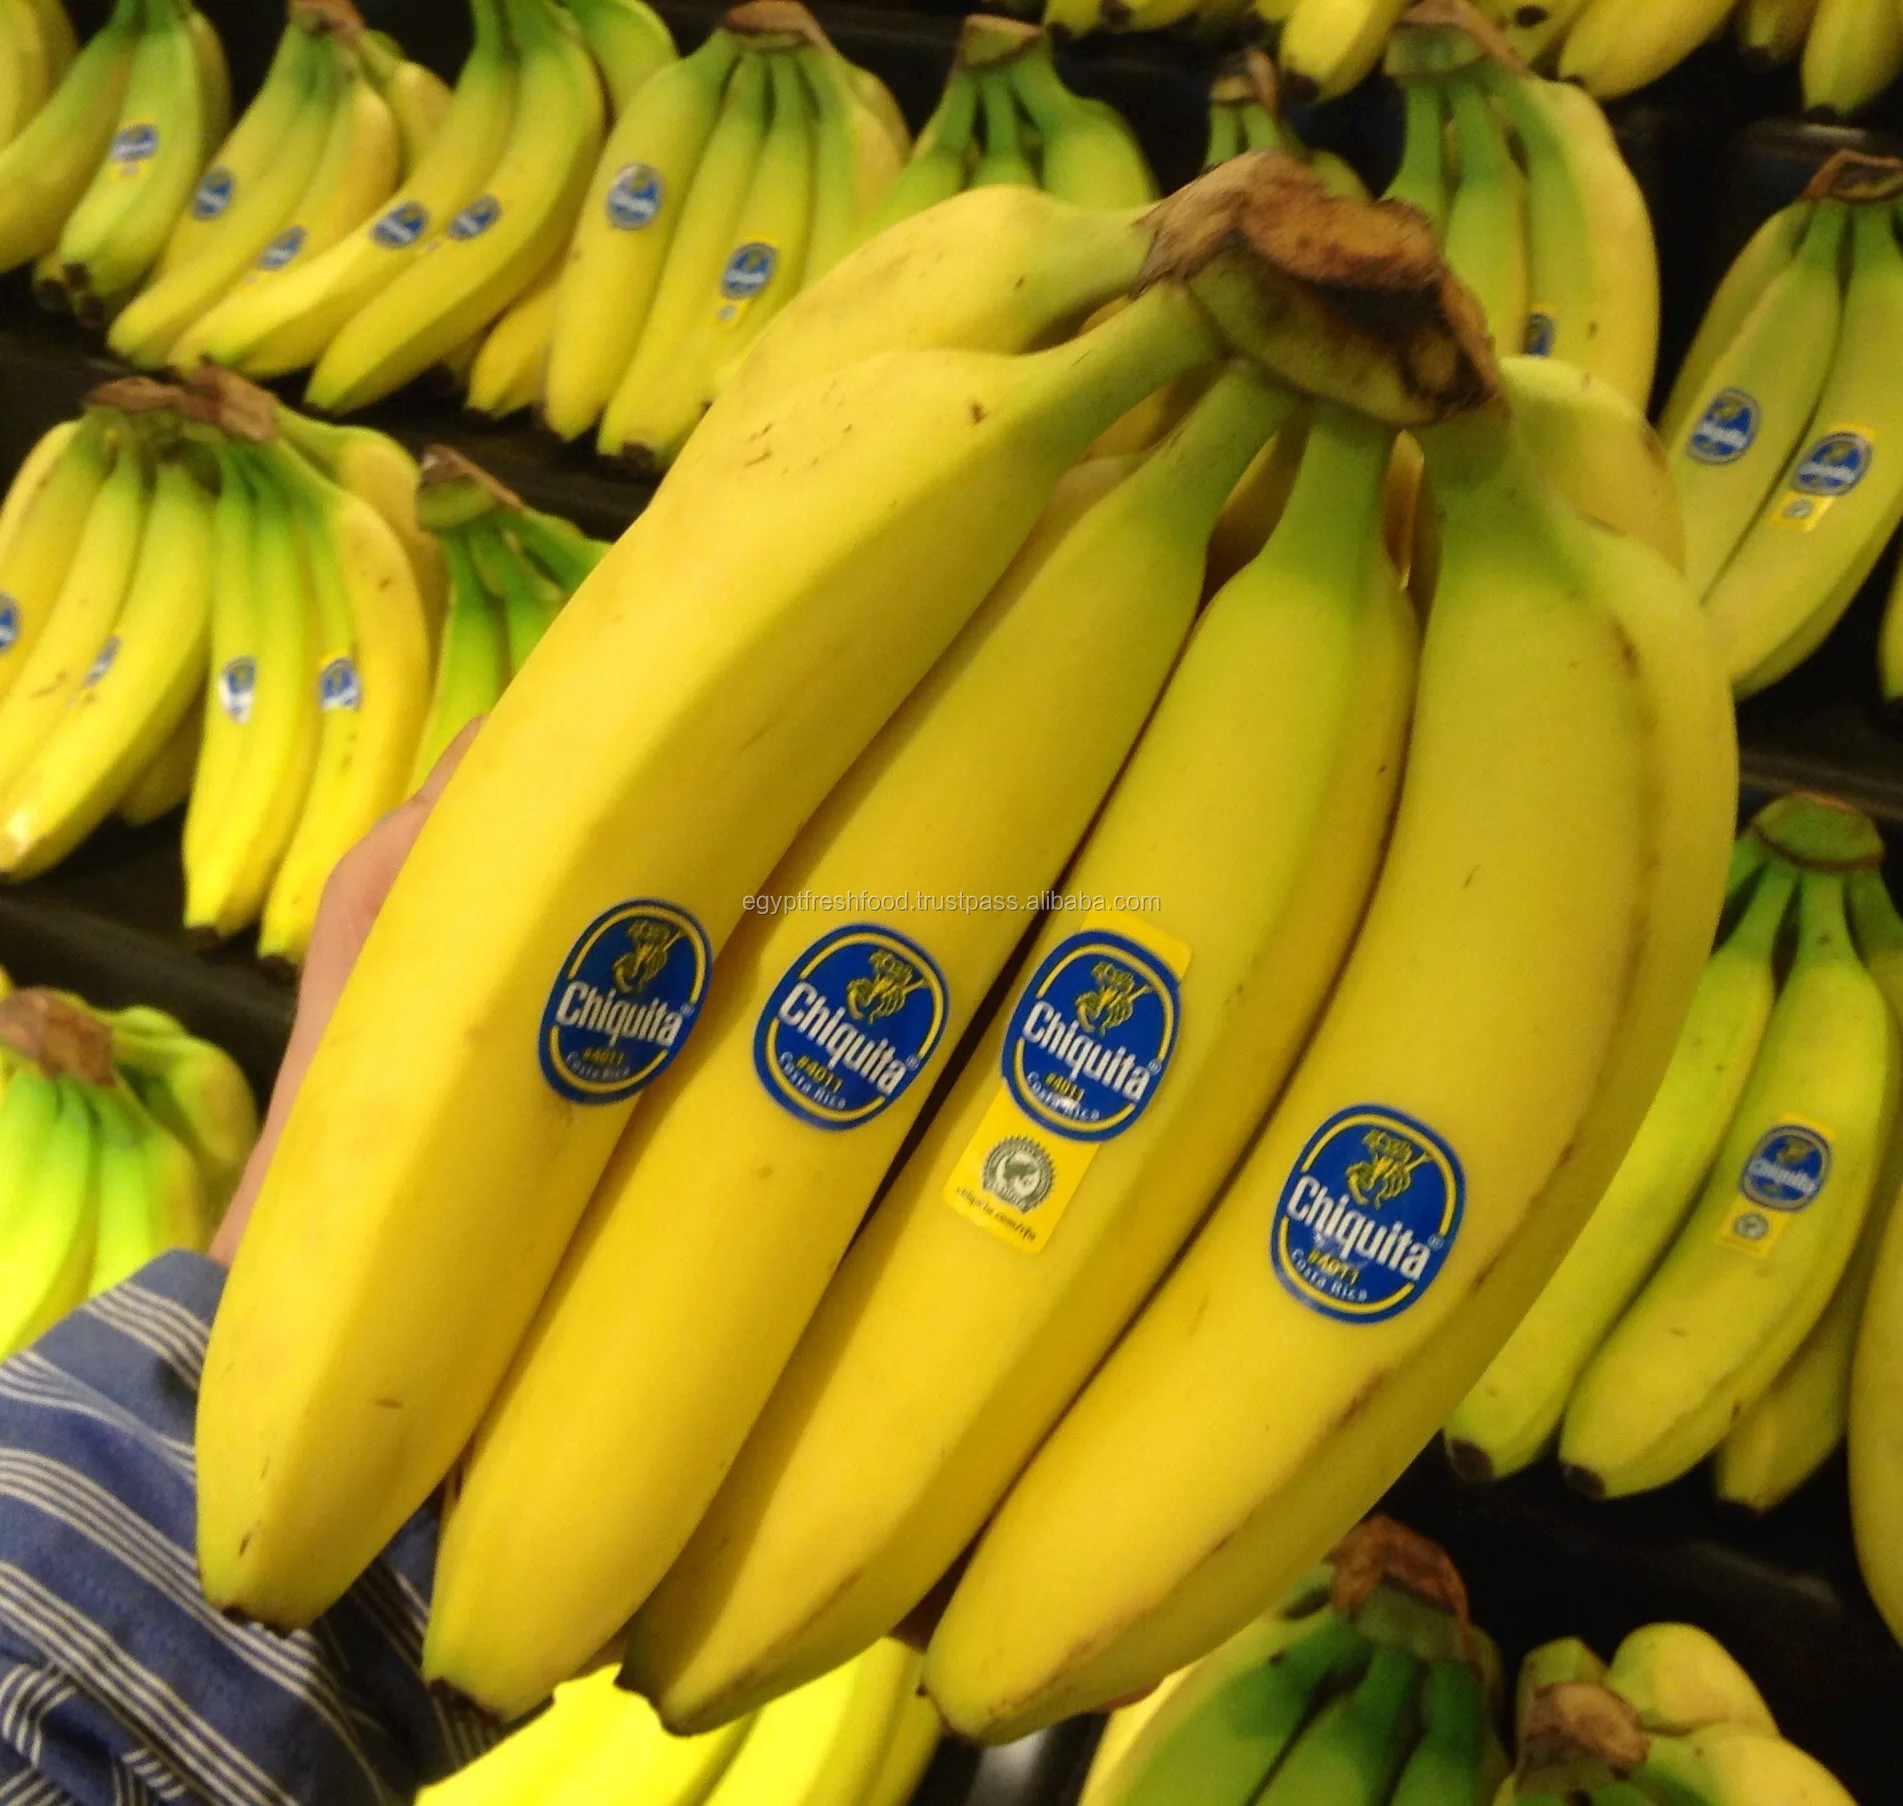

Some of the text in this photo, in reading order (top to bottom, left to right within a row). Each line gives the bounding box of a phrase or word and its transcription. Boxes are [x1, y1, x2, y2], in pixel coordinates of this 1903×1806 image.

[555, 980, 683, 1048] Chiquita
[778, 981, 907, 1096] Chiquita
[797, 1055, 844, 1093] #4011
[1022, 1000, 1151, 1101] Chiquita
[1286, 1175, 1431, 1281] Chiquita
[1290, 1248, 1368, 1302] Costa Rica
[1308, 1250, 1360, 1285] #4011
